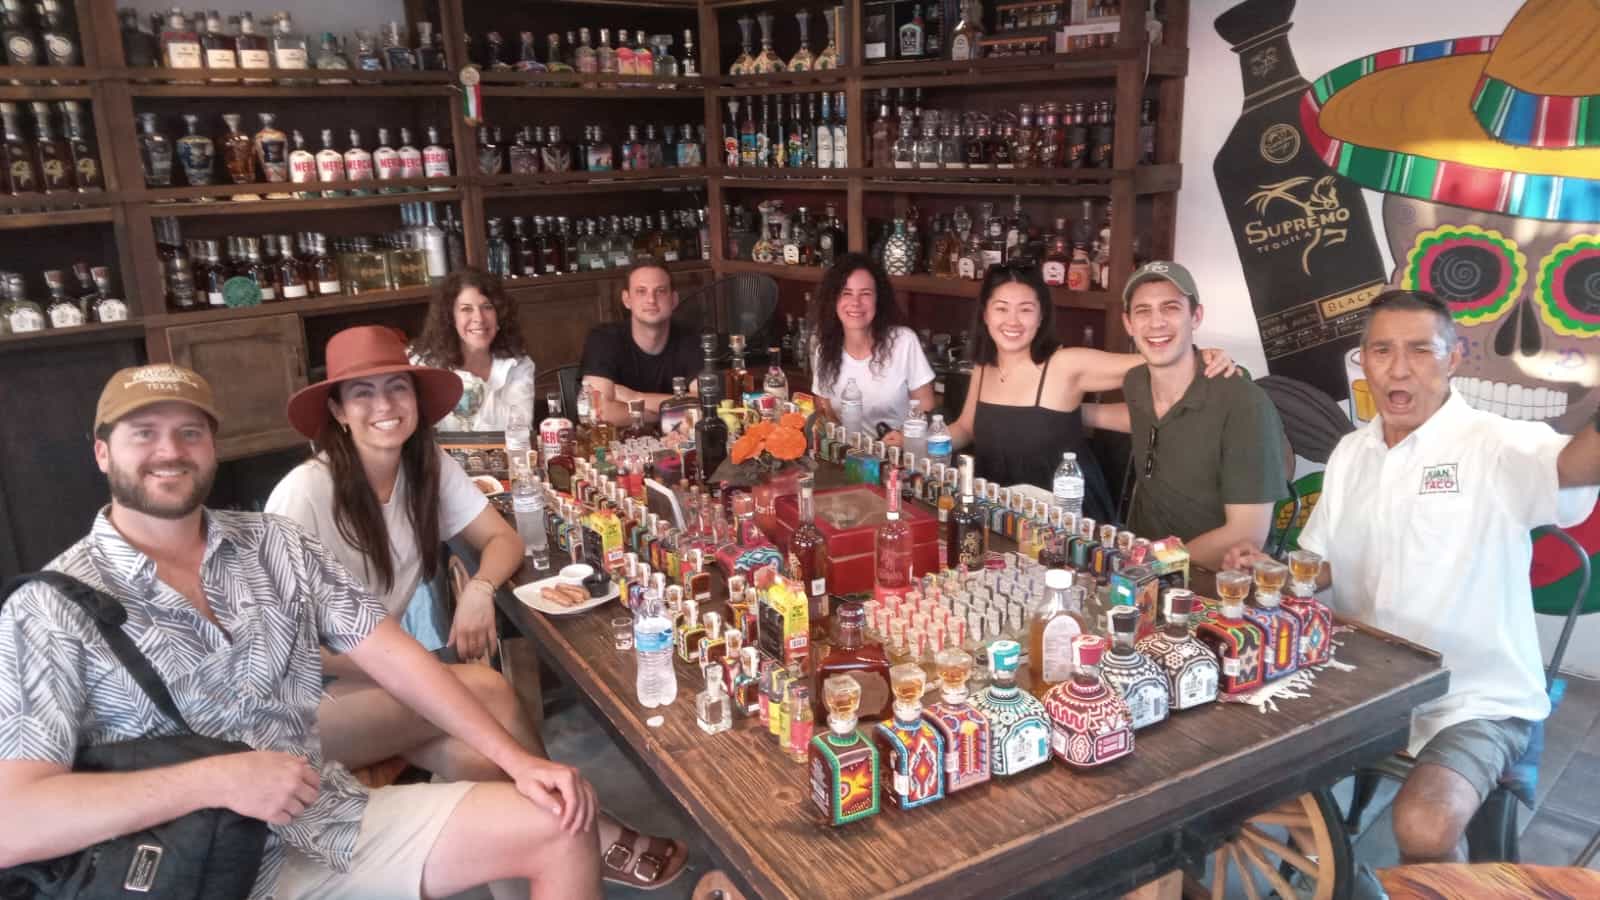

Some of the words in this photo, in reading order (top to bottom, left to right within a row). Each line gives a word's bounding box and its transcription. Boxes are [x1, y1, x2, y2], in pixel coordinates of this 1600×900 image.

[1245, 207, 1350, 245] SUPREMO
[1257, 231, 1312, 253] TEQUILA
[1327, 290, 1376, 313] BLACK
[146, 383, 180, 392] TEXAS
